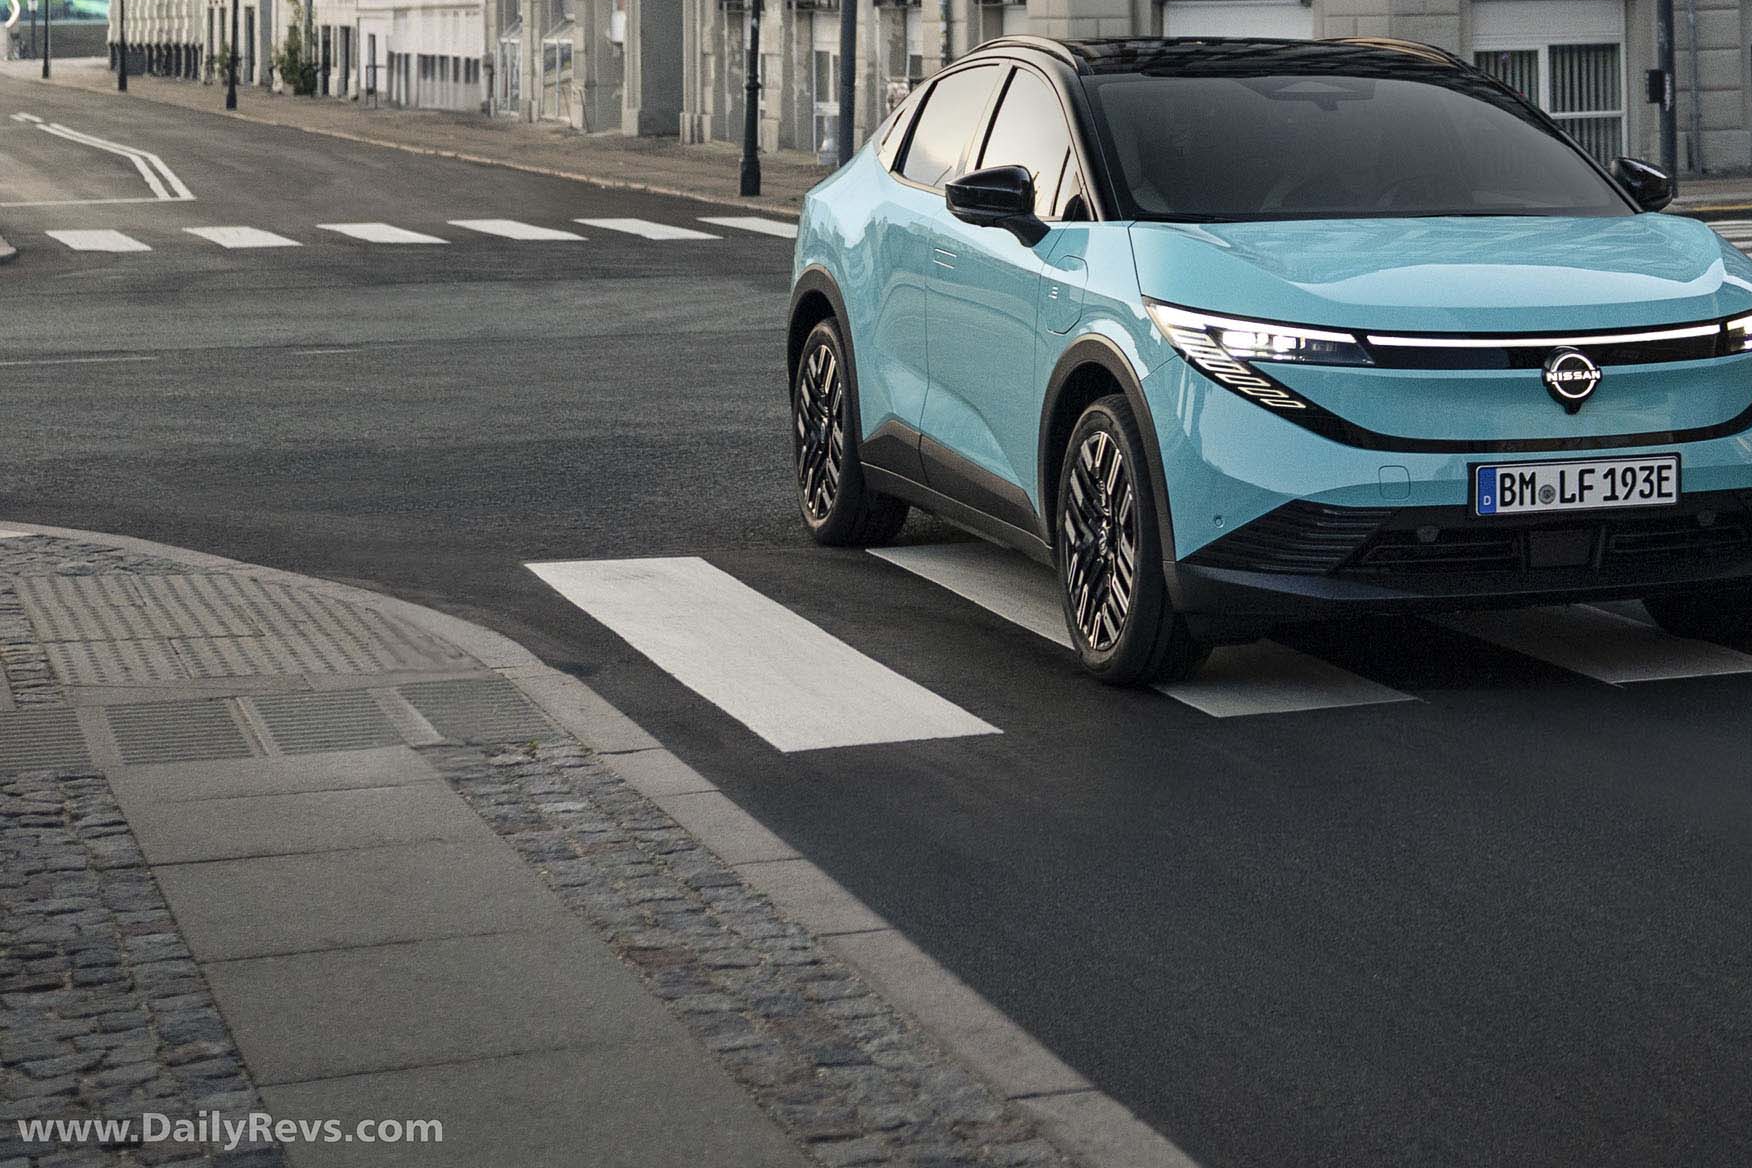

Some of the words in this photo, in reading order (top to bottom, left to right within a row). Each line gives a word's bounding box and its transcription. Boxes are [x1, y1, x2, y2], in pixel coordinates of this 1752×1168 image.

[1546, 369, 1601, 383] NISSAN
[1499, 471, 1537, 507] BM
[1559, 468, 1596, 504] LF
[1603, 464, 1673, 502] 193E
[1483, 495, 1491, 506] D
